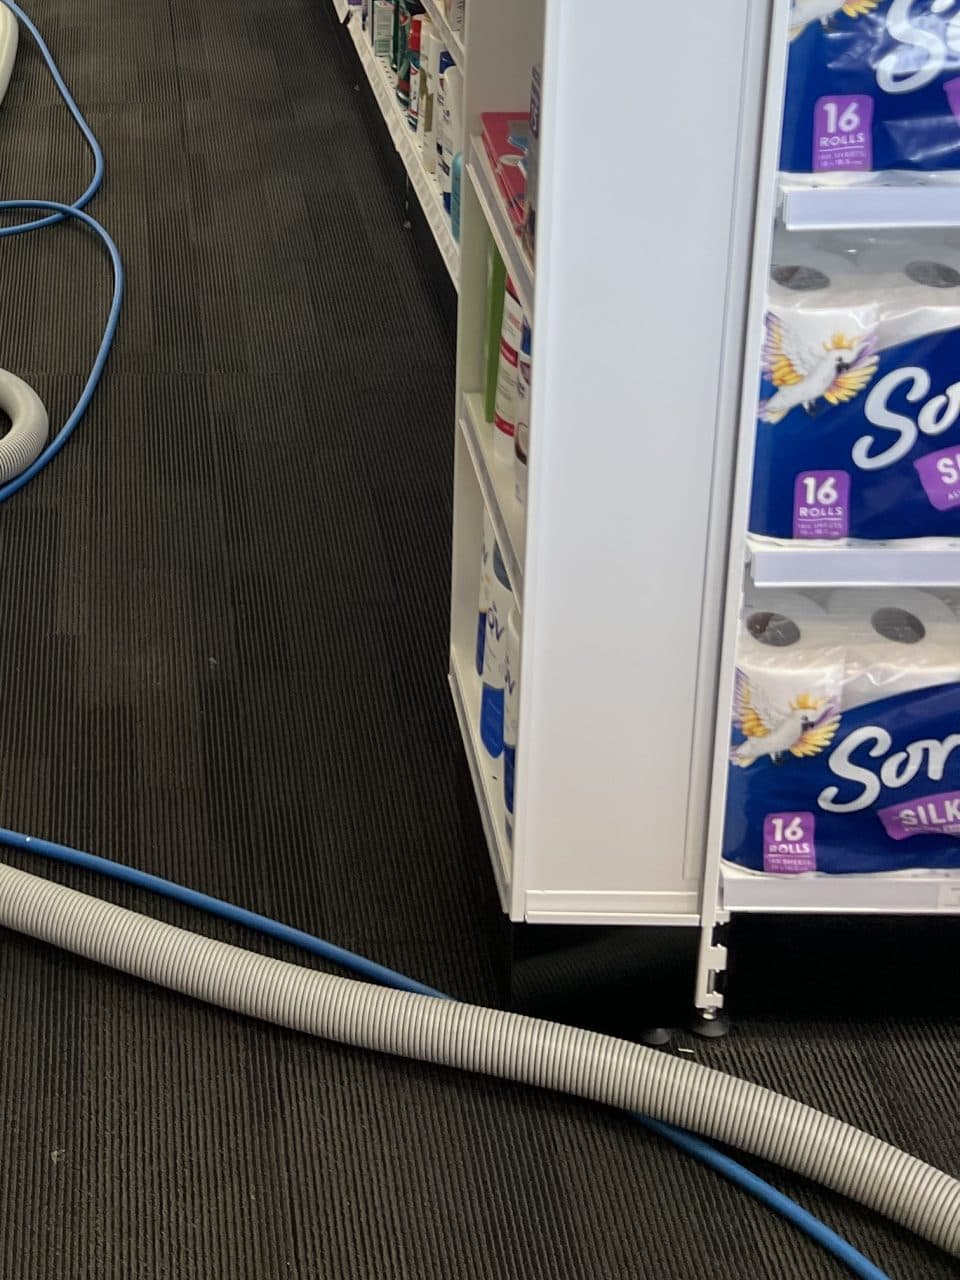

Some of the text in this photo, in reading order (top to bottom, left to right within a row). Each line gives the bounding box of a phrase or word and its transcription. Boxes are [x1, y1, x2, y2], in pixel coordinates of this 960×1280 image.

[823, 102, 861, 134] 16
[819, 132, 865, 147] ROLLS
[803, 477, 838, 505] 16
[799, 506, 843, 517] ROLLS
[771, 817, 804, 841] 16
[769, 843, 810, 854] ROLLS
